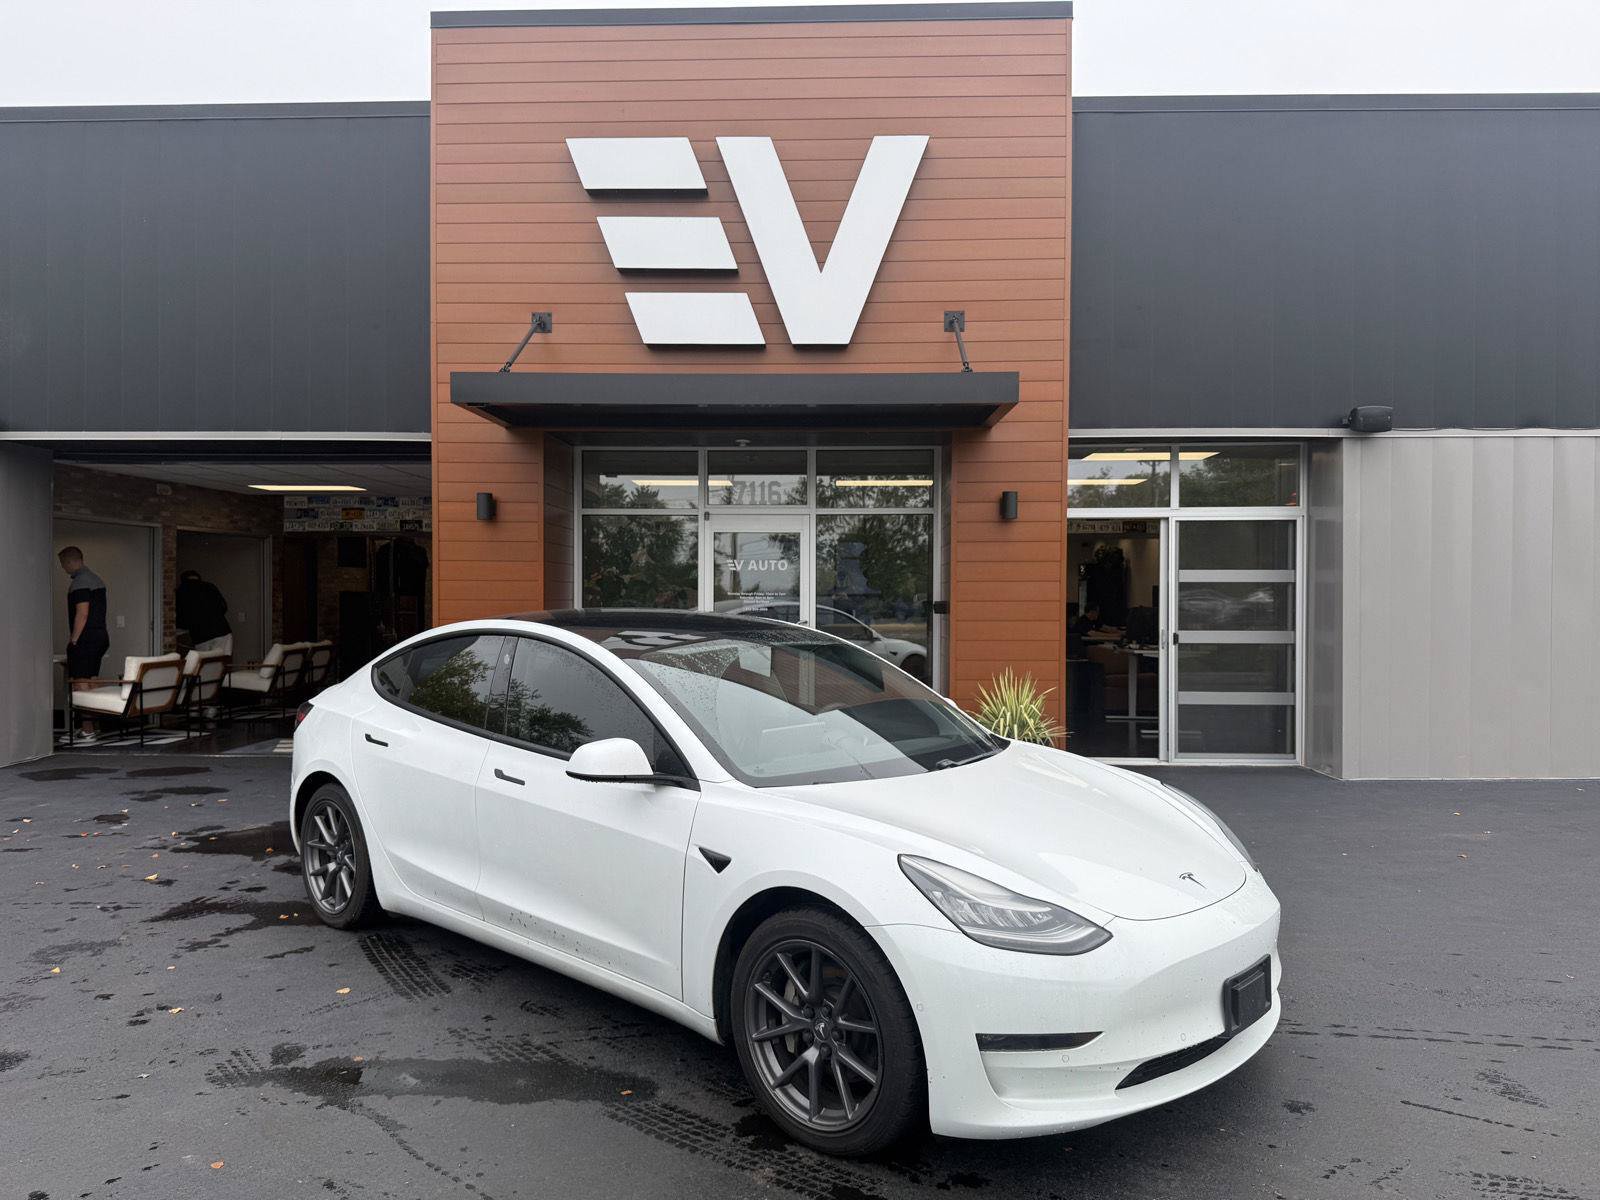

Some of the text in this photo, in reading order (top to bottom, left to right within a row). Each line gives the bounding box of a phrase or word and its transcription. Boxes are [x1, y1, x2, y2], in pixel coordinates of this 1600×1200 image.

[565, 135, 931, 347] EV
[734, 480, 782, 505] 7116
[727, 559, 788, 571] EV AUTO
